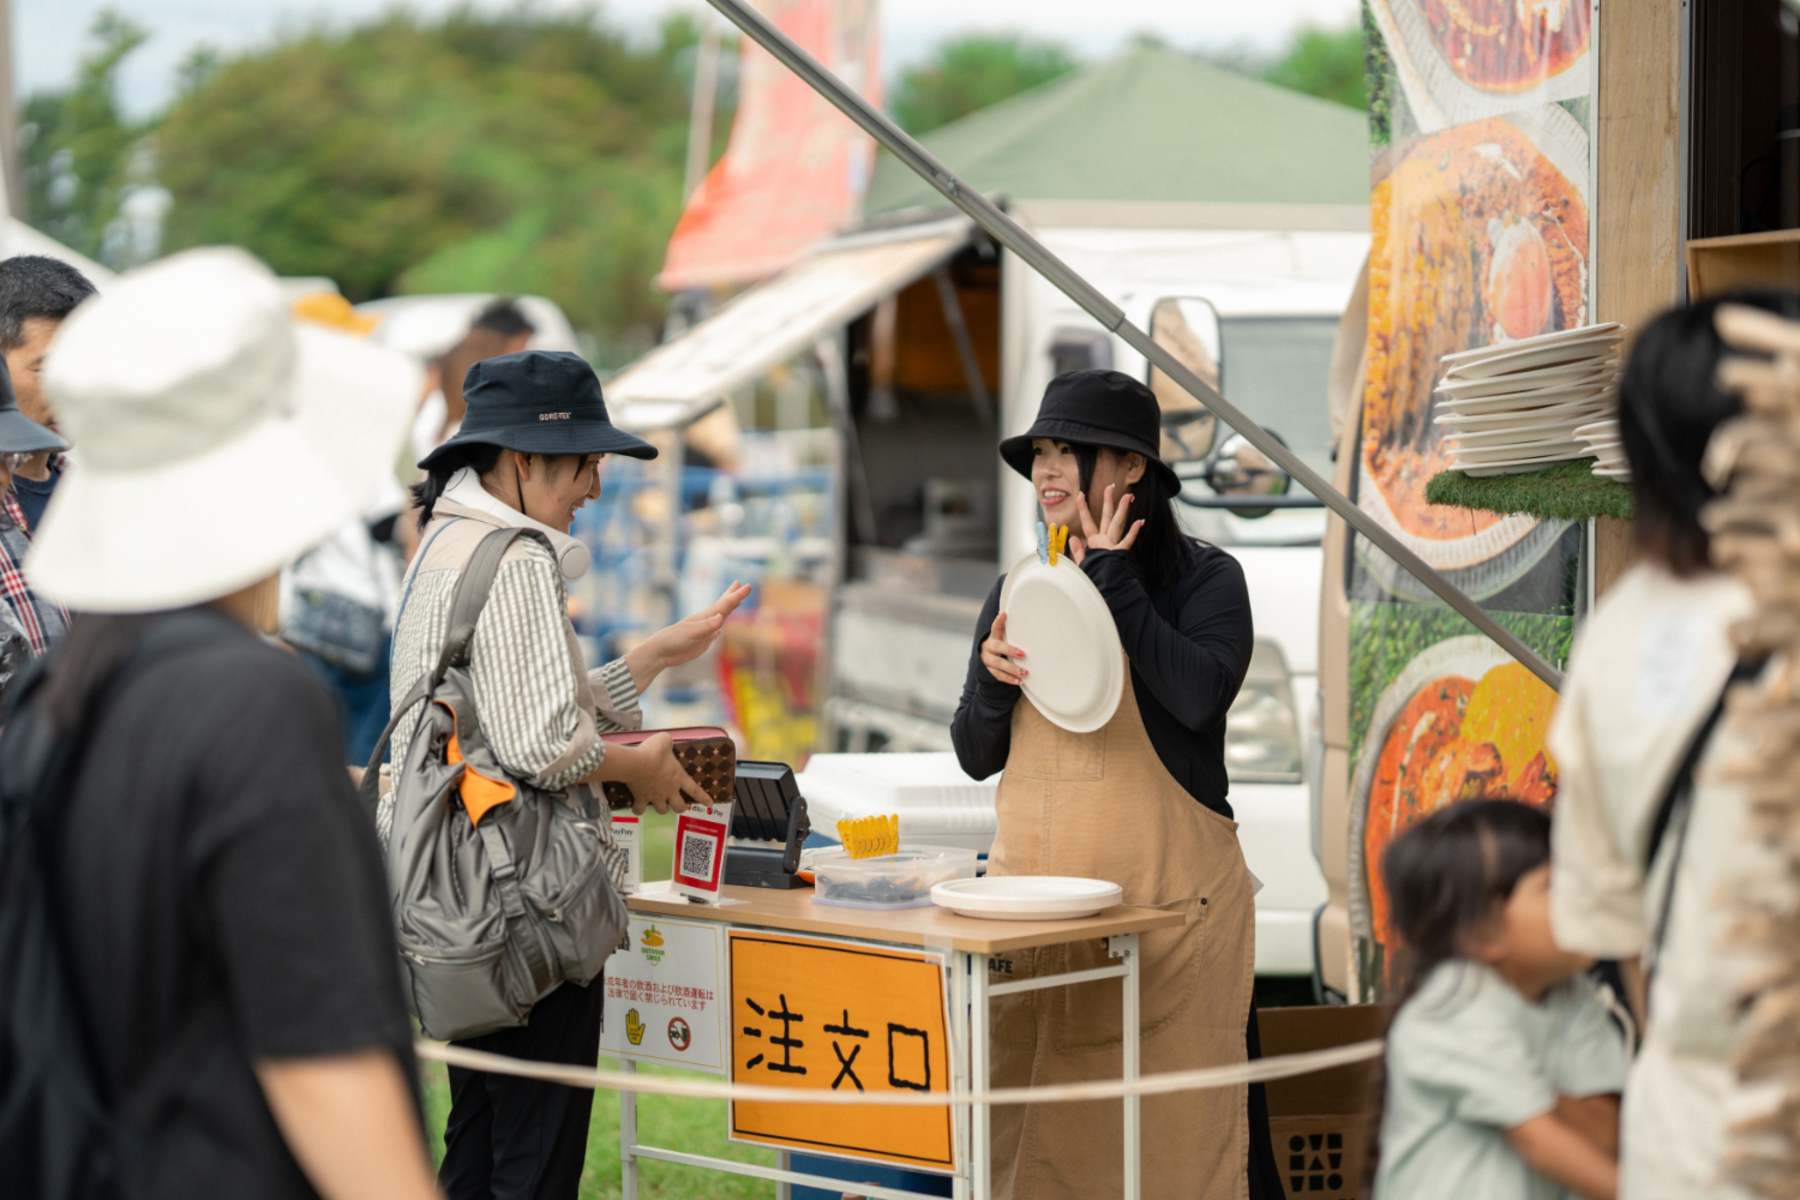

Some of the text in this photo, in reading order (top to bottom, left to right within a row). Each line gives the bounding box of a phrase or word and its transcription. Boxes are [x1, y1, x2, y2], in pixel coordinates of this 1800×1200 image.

[641, 947, 665, 956] OUTDOOR
[646, 954, 661, 962] SMILE
[742, 993, 931, 1093] 注文口
